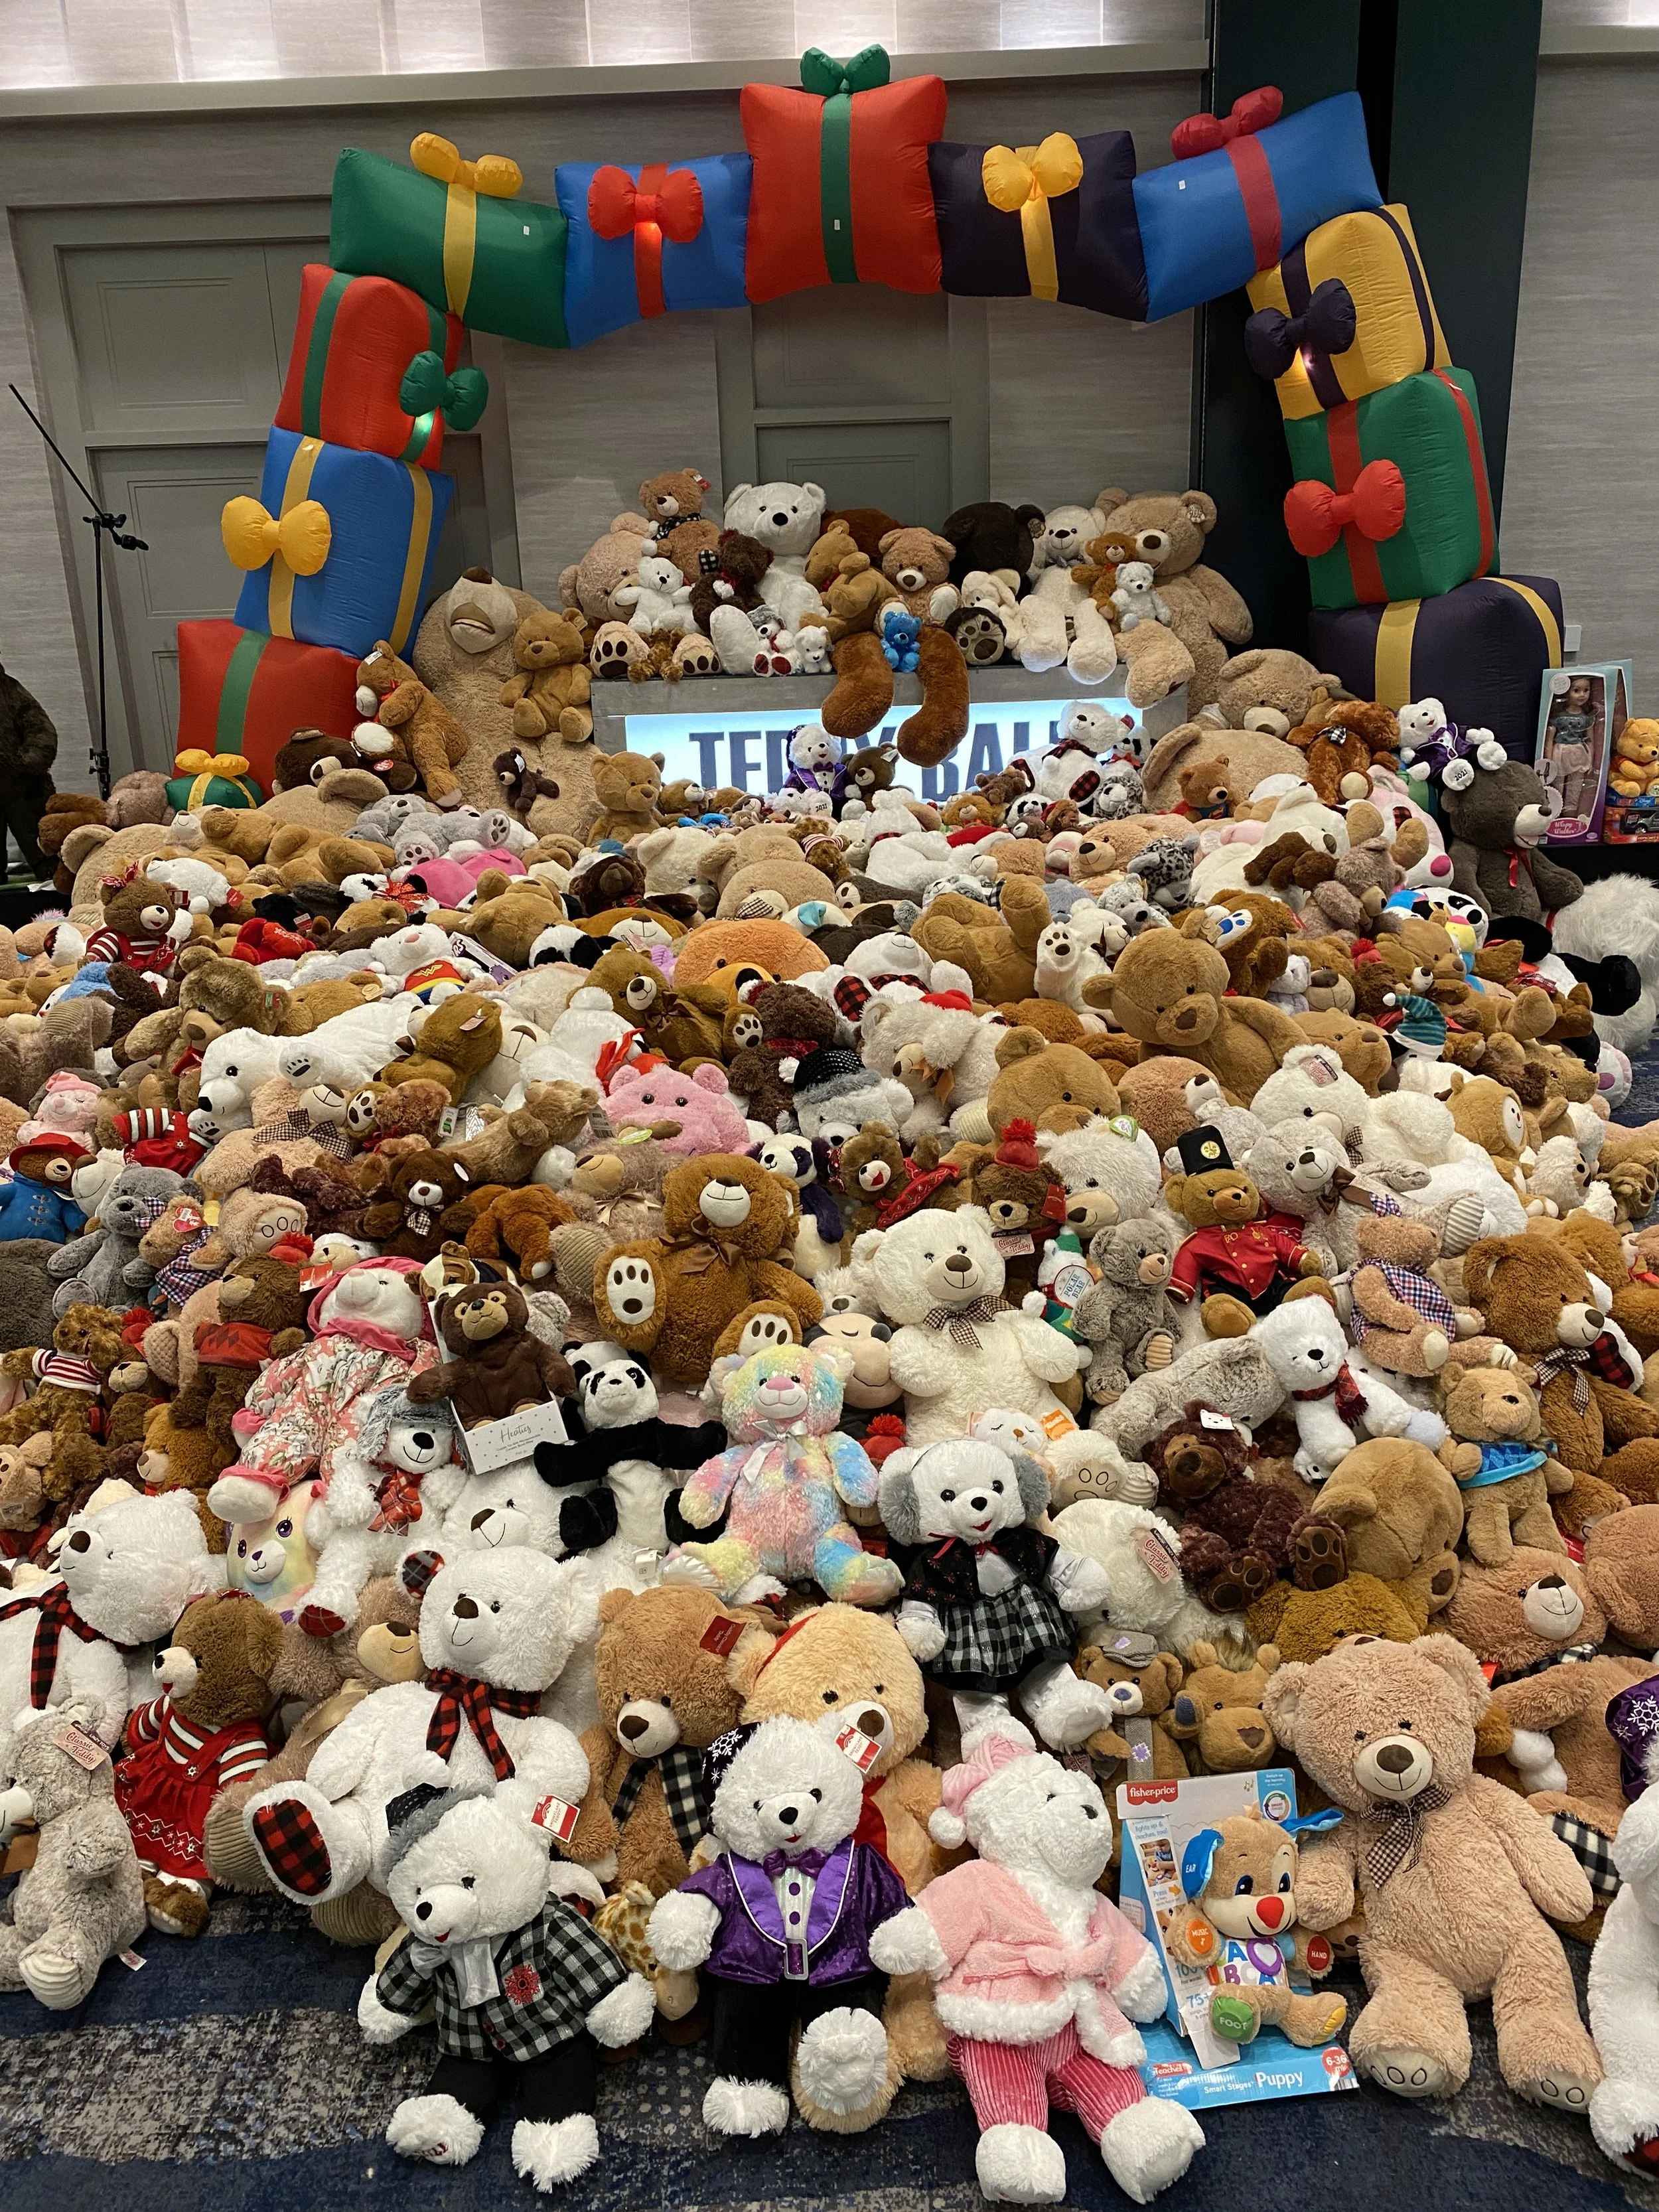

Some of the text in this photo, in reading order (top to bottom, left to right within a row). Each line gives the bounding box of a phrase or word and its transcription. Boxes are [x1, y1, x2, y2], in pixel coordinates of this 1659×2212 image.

[1455, 769, 1468, 781] 2021
[816, 804, 828, 812] 2021
[998, 1236, 1021, 1248] Classic
[1010, 1242, 1030, 1254] Teddy
[1064, 1273, 1080, 1297] POLAR
[1072, 1280, 1086, 1299] BEAR
[500, 1423, 532, 1443] Heaties
[1145, 1539, 1168, 1560] Classic
[1149, 1554, 1168, 1576] Teddy
[66, 1732, 94, 1749] Classic
[99, 1740, 110, 1751] TOYS
[71, 1745, 94, 1763] Teddy
[1129, 1785, 1176, 1798] fisher-price
[549, 1802, 561, 1828] SNOWFLAKE
[1186, 1864, 1196, 1873] EAR
[1191, 1928, 1209, 1937] MUSIC
[1311, 1951, 1327, 1959] HAND
[1220, 2016, 1248, 2030] FOOT
[1325, 2055, 1348, 2066] 6-36
[1256, 2071, 1303, 2090] Puppy
[1204, 2084, 1226, 2095] Smart
